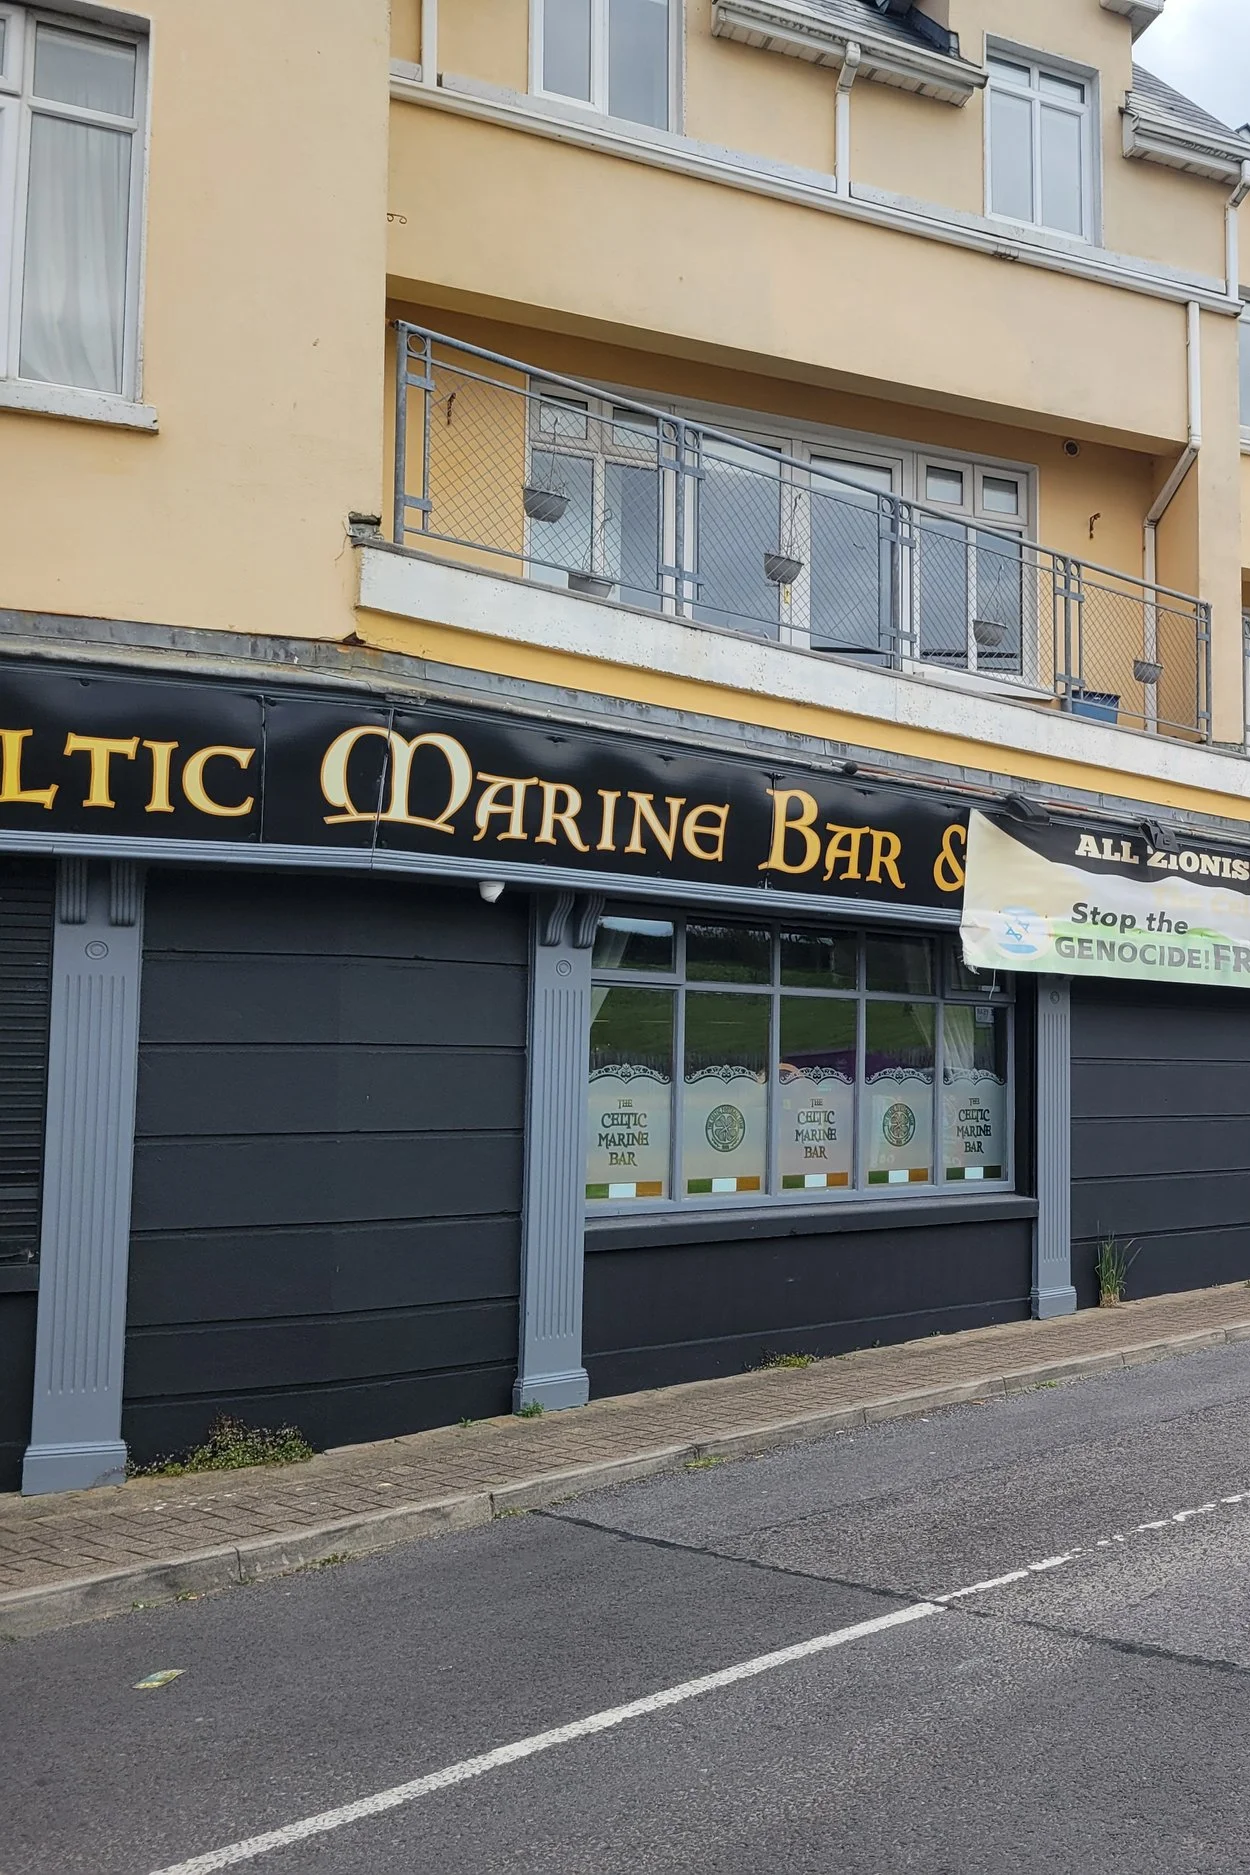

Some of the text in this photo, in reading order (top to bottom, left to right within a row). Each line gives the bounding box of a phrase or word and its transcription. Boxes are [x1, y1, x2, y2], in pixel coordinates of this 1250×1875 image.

[320, 725, 730, 862] MARINE
[757, 788, 905, 889] BAR
[933, 824, 966, 892] &
[1075, 834, 1139, 865] ALL
[1071, 902, 1188, 935] Stop the
[1054, 936, 1209, 970] GENOCIDE!
[601, 1112, 648, 1129] CELTIC
[797, 1110, 836, 1125] CELTIC
[958, 1109, 991, 1122] CELTIC
[597, 1131, 650, 1149] MARINE
[795, 1127, 837, 1144] MARINE
[956, 1124, 992, 1139] MARINE
[804, 1146, 828, 1159] BAR
[964, 1141, 985, 1154] BAR
[608, 1152, 638, 1167] BAR
